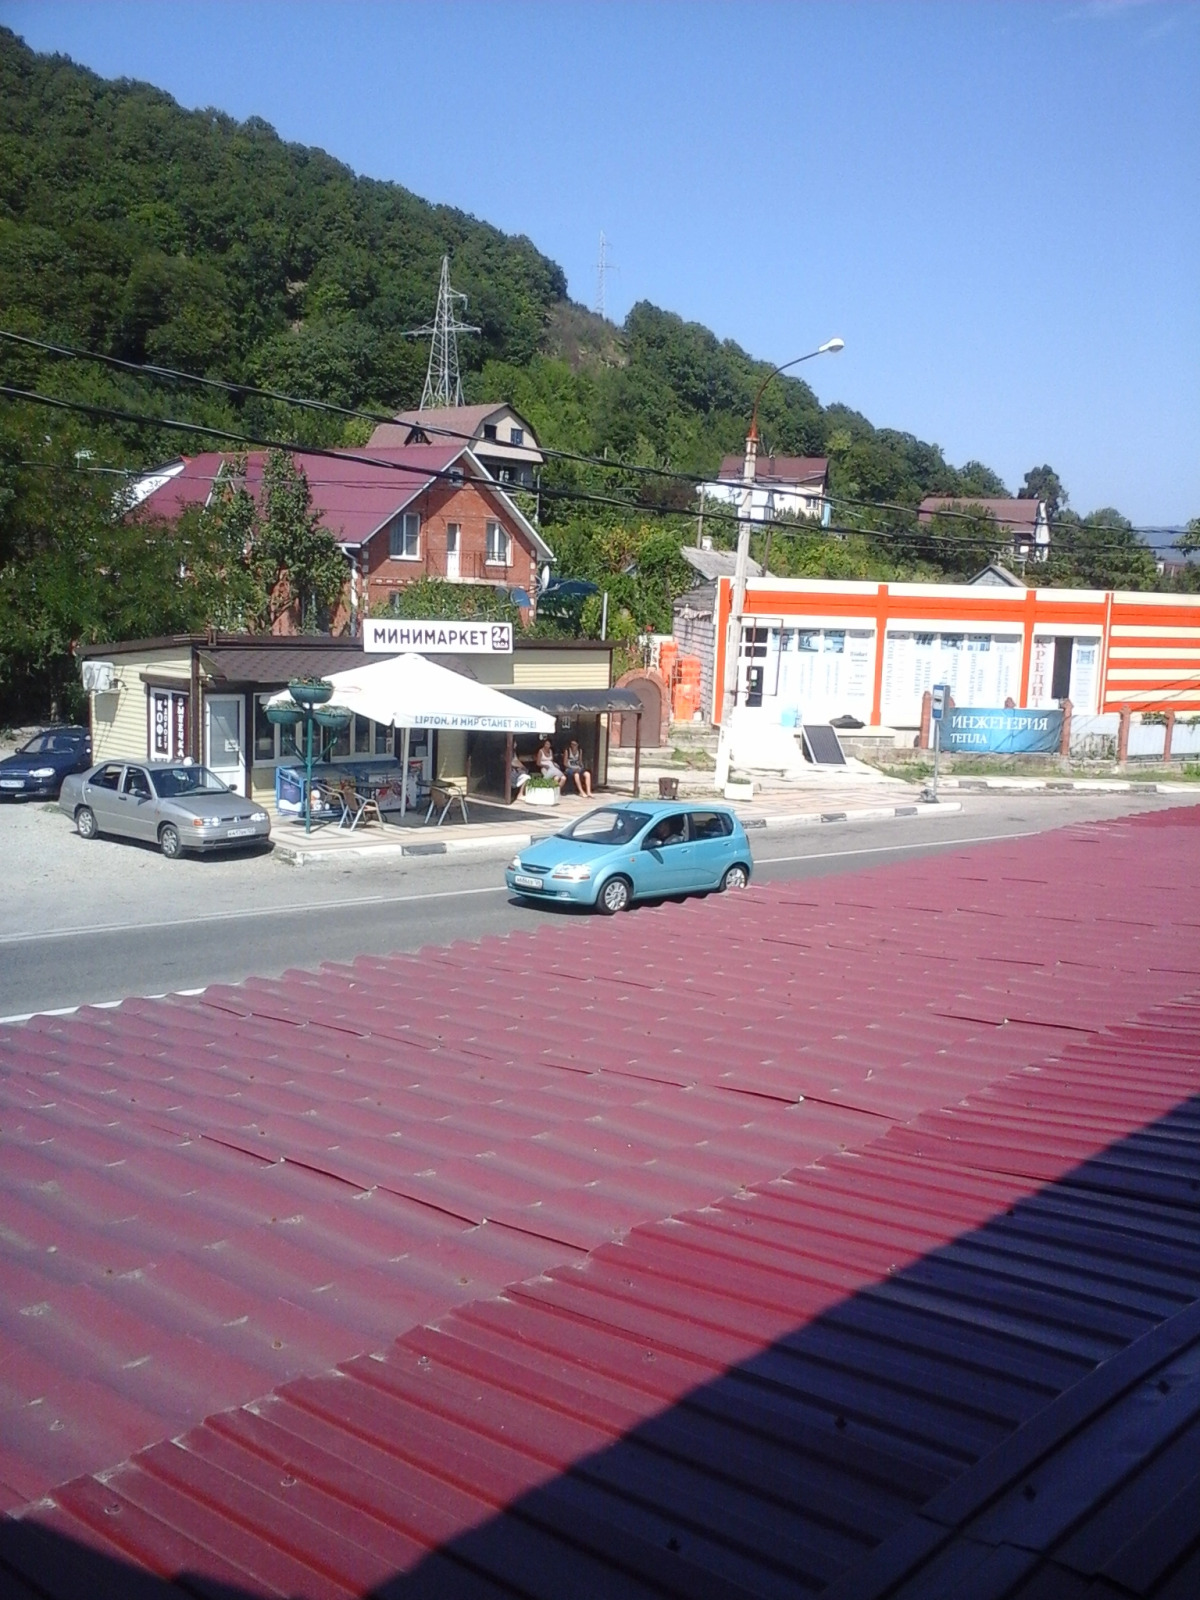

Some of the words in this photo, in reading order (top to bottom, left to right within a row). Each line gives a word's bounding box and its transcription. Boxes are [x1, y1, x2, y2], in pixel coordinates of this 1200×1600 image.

[373, 628, 488, 645] МИНИМАРКЕТ
[493, 627, 508, 641] 24
[1032, 639, 1046, 707] КРЕДИТ
[177, 697, 185, 757] ВЫПЕЧКА
[451, 717, 458, 726] И
[460, 717, 479, 727] МИР
[481, 719, 511, 728] СТАНЕТ
[514, 720, 537, 729] ЯРЧЕ!
[952, 716, 1049, 730] ИНЖЕНЕРИЯ
[950, 733, 988, 744] ТЕПЛА
